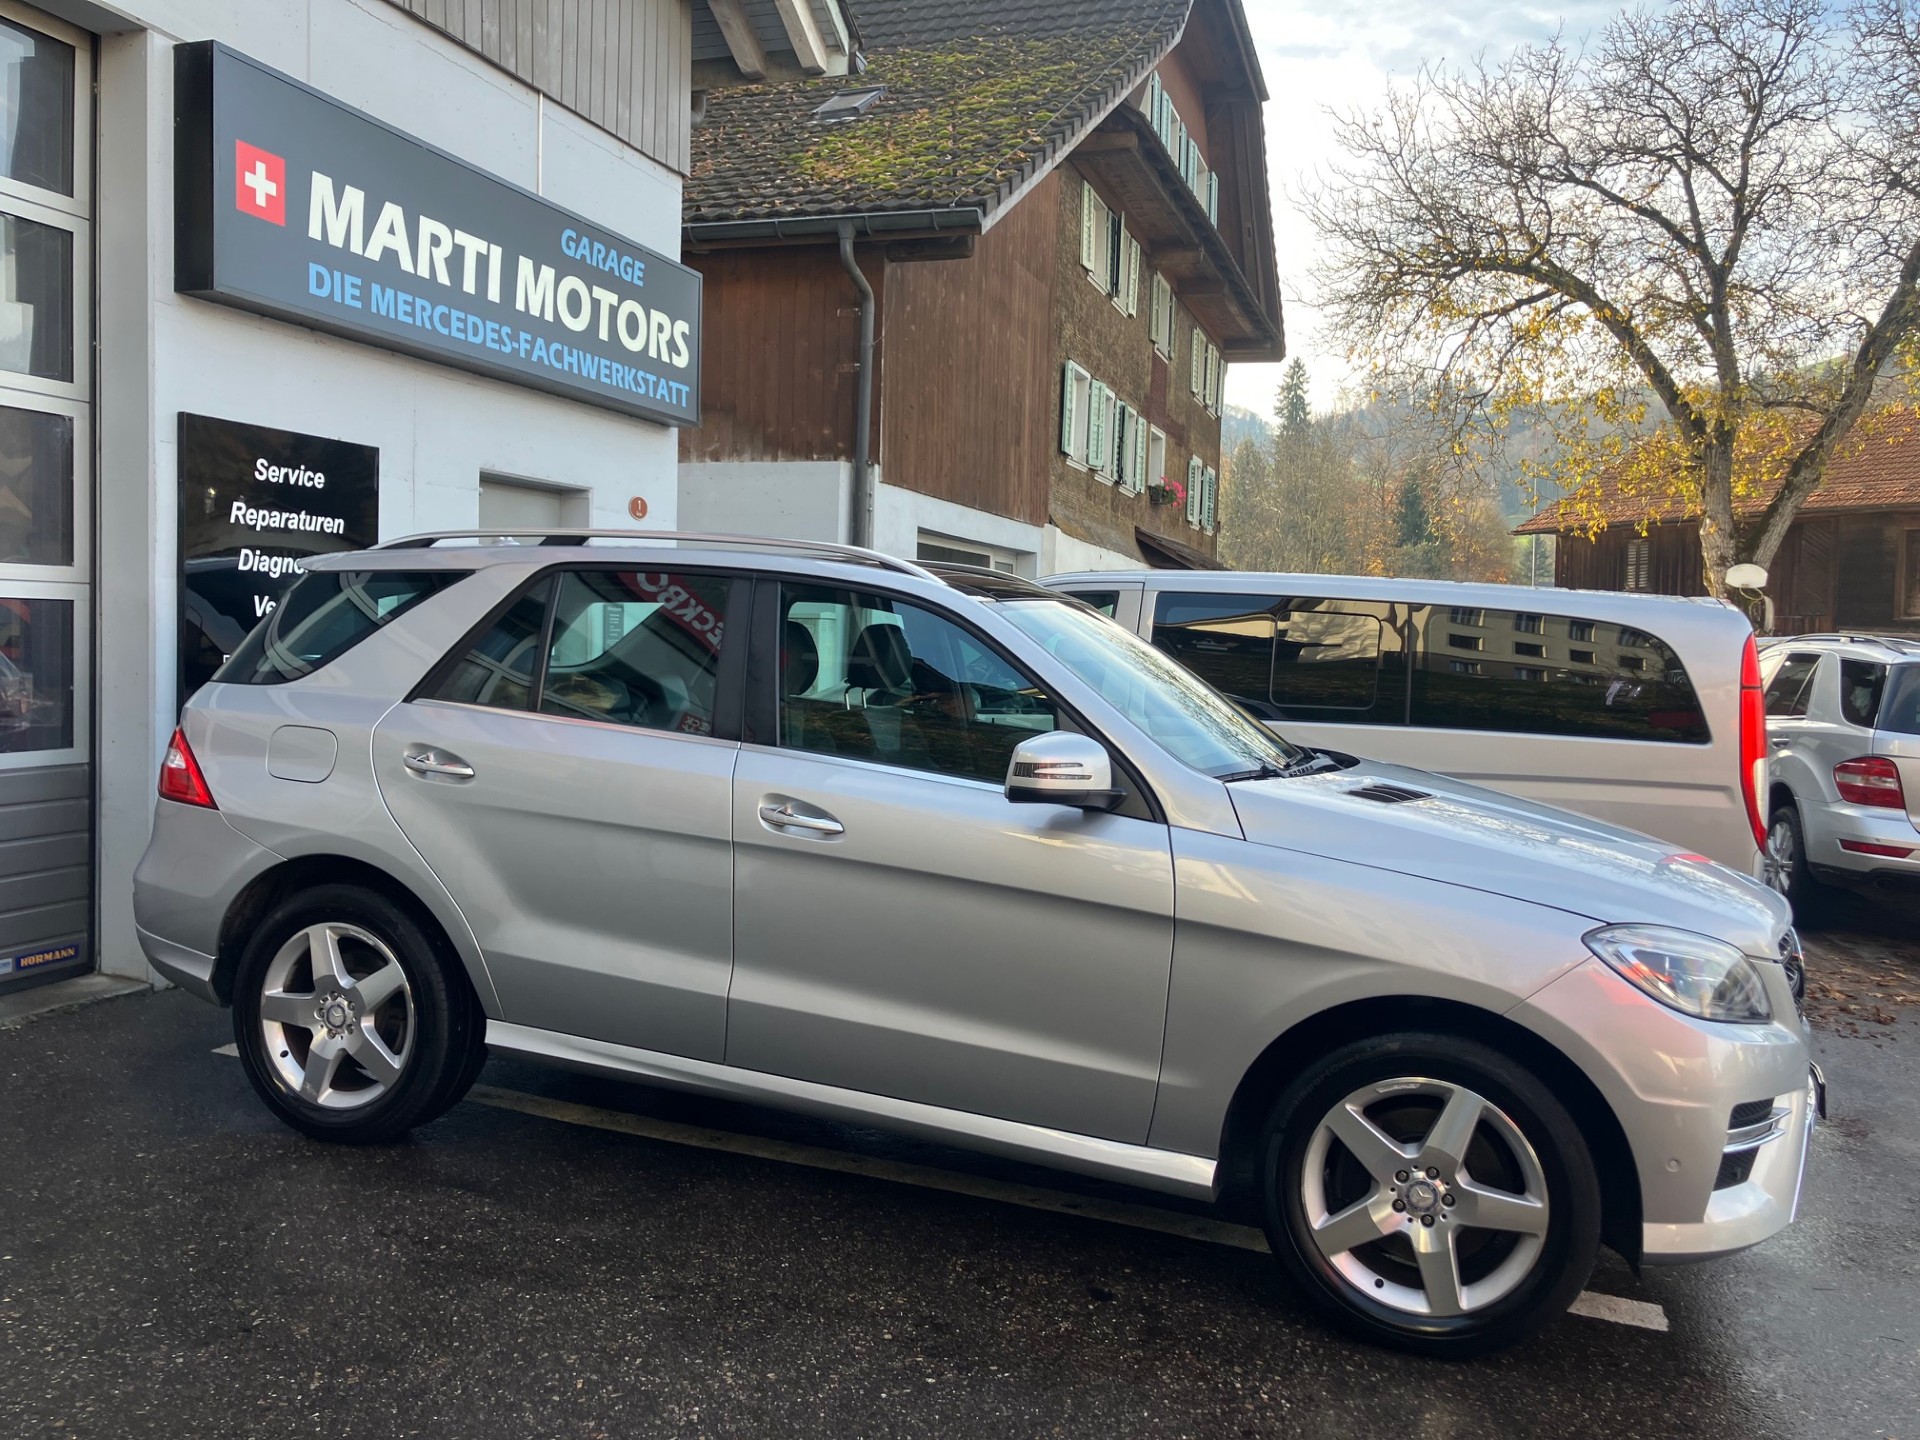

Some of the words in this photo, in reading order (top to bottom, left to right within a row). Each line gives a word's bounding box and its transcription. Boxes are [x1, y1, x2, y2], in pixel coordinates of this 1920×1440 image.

[308, 171, 502, 303] MARTI
[515, 254, 690, 368] MOTORS
[561, 229, 645, 286] GARAGE
[308, 262, 362, 308] DIE
[371, 282, 690, 407] MERCEDES-FACHWERKSTATT
[254, 458, 326, 489] Service
[230, 501, 344, 534] Reparaturen
[238, 548, 308, 578] Diagno
